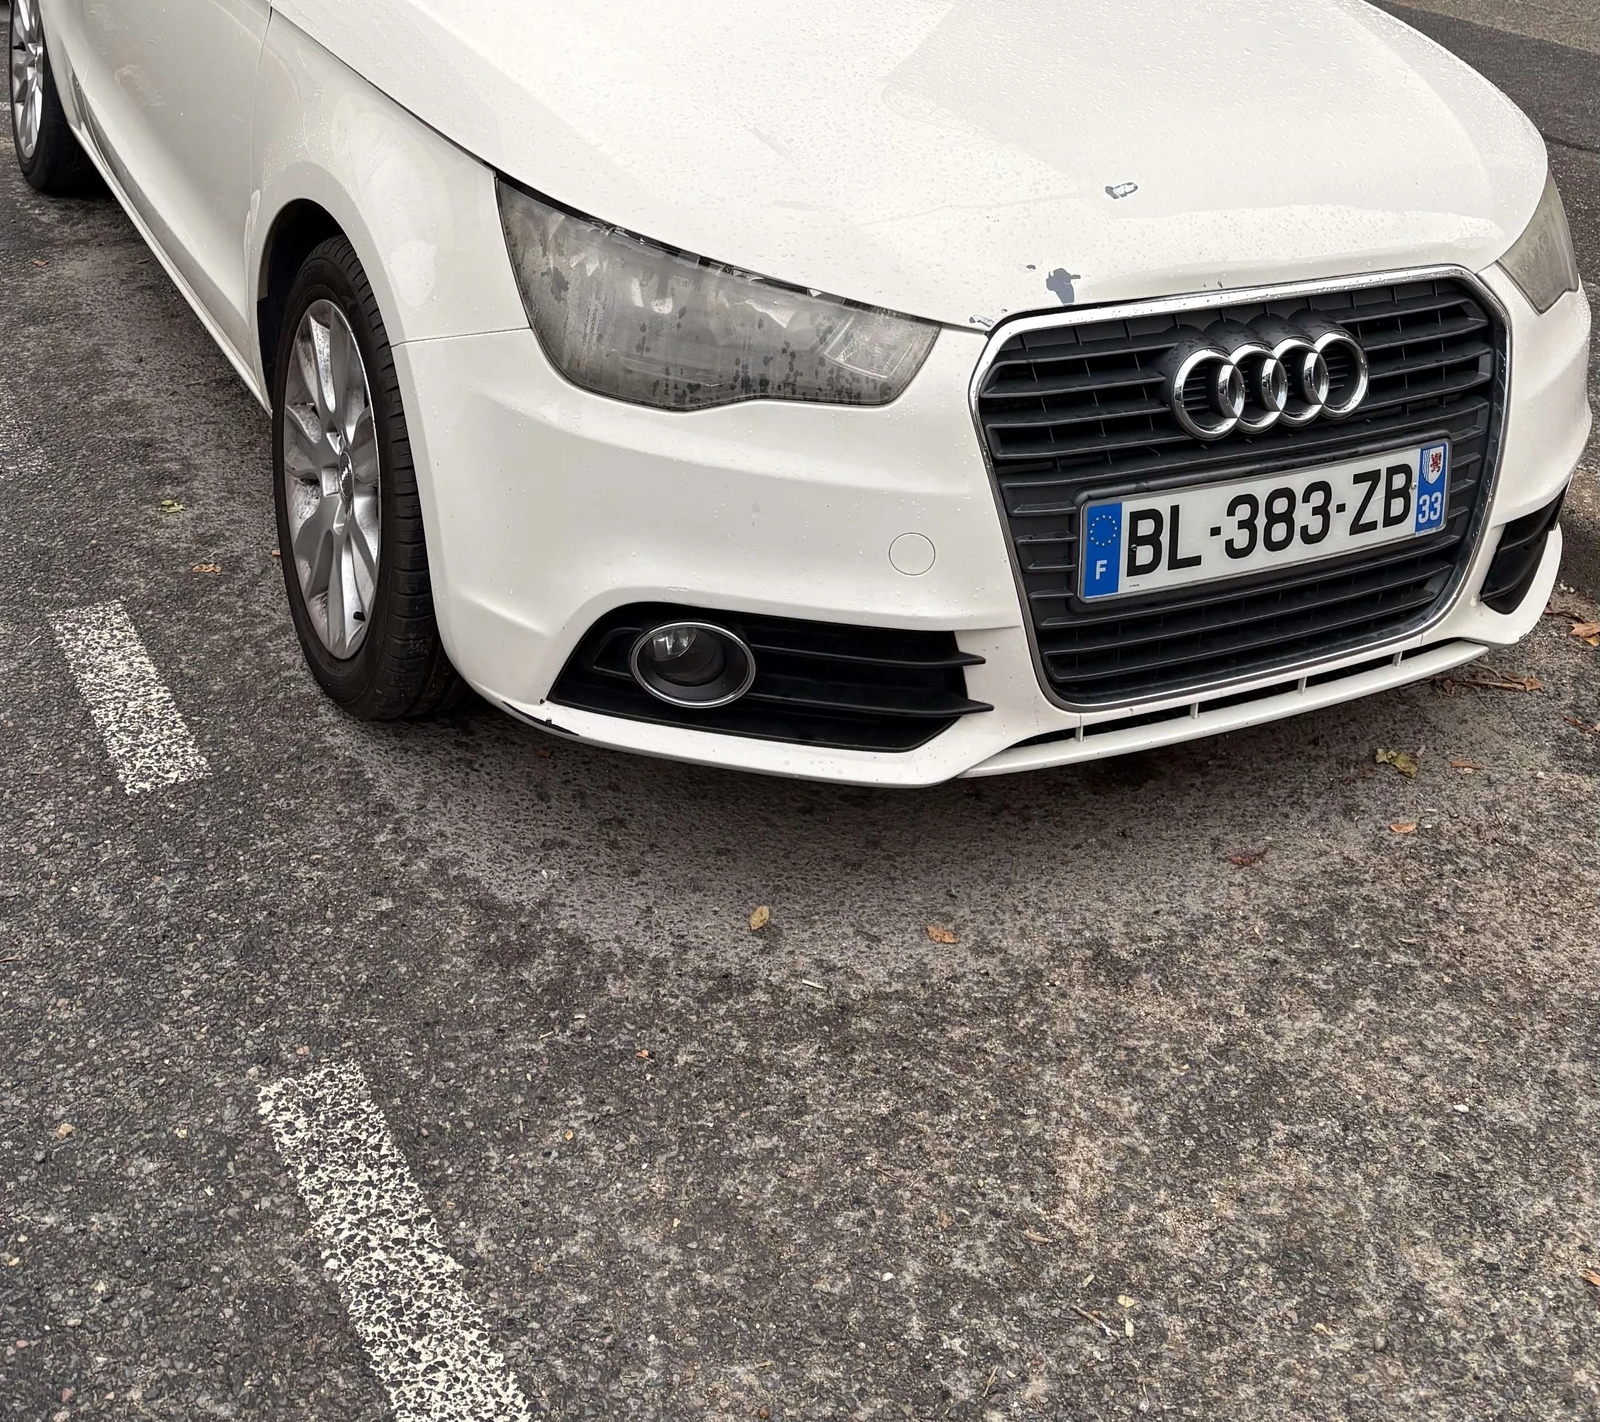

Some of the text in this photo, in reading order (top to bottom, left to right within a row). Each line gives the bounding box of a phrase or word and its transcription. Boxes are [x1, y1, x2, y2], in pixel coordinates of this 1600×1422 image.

[1126, 463, 1413, 578] BL-383-ZB
[1418, 491, 1442, 525] 33
[1095, 559, 1107, 580] F
